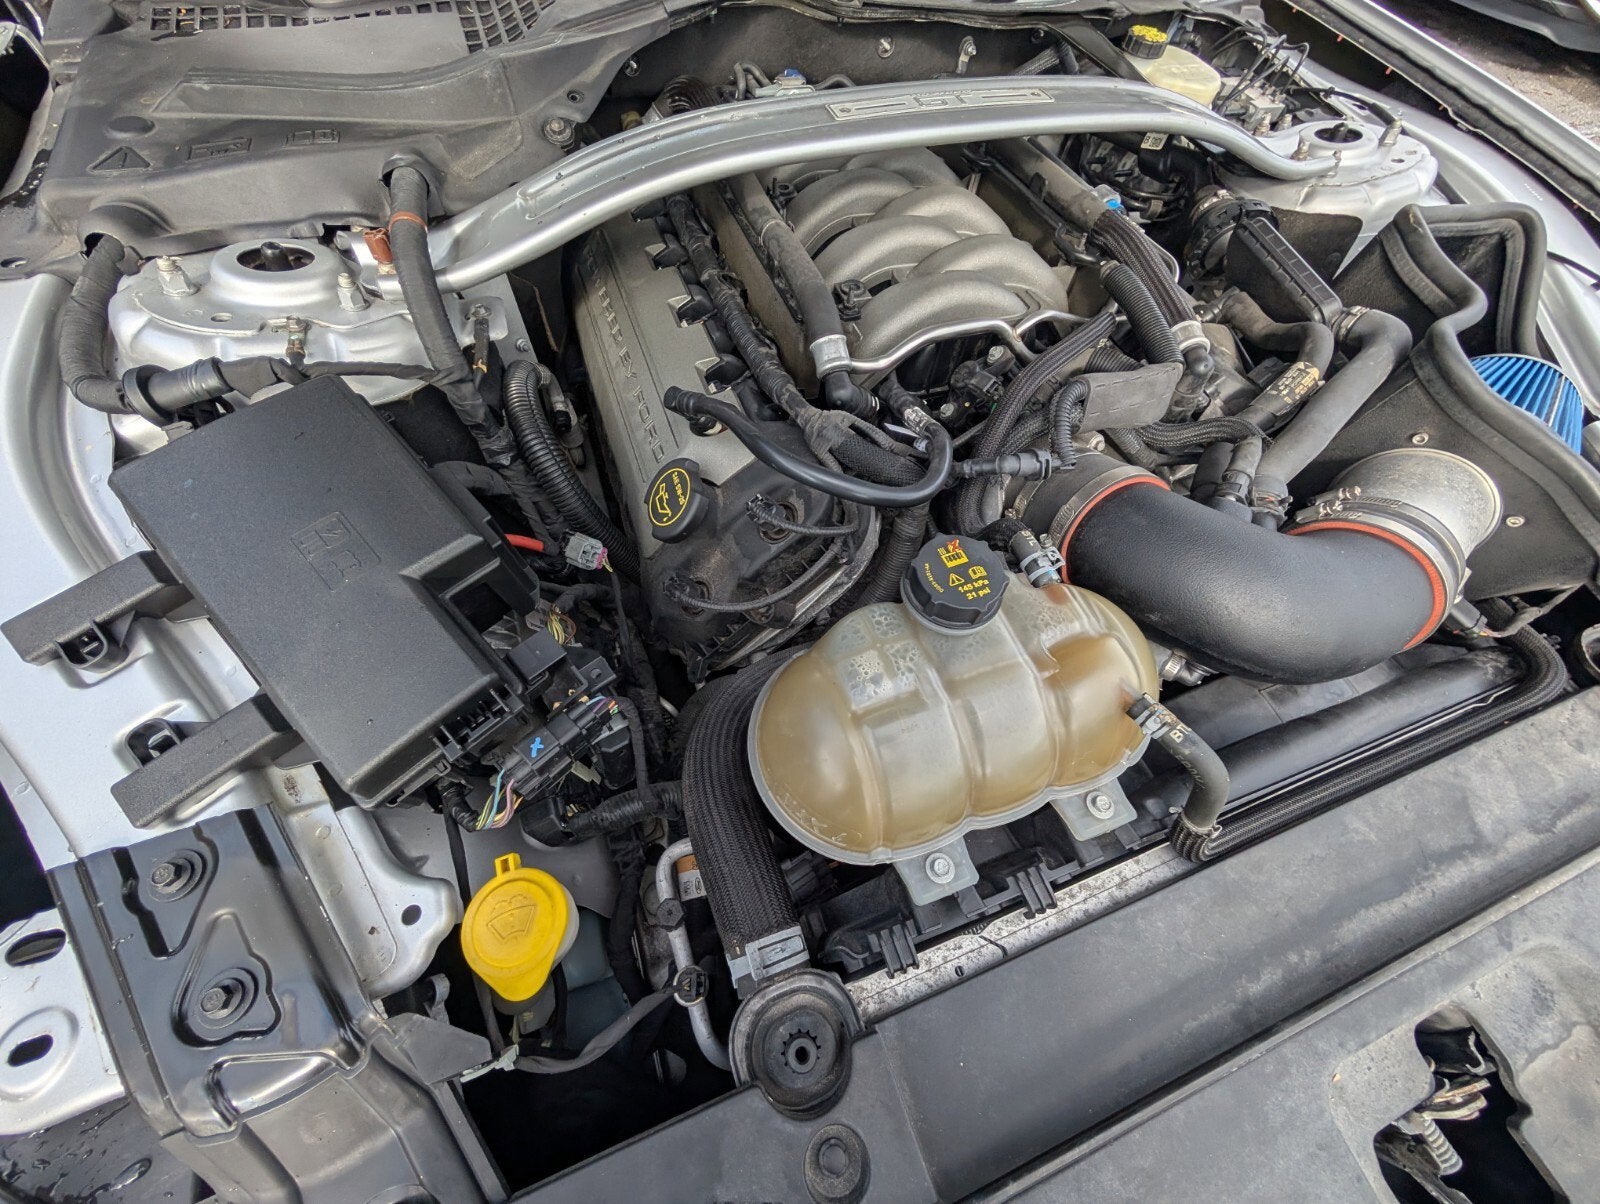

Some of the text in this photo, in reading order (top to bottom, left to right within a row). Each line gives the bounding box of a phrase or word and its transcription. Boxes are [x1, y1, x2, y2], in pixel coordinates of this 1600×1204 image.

[632, 386, 665, 464] FORD
[958, 579, 990, 593] 145 kPa
[966, 587, 991, 600] 21 psi
